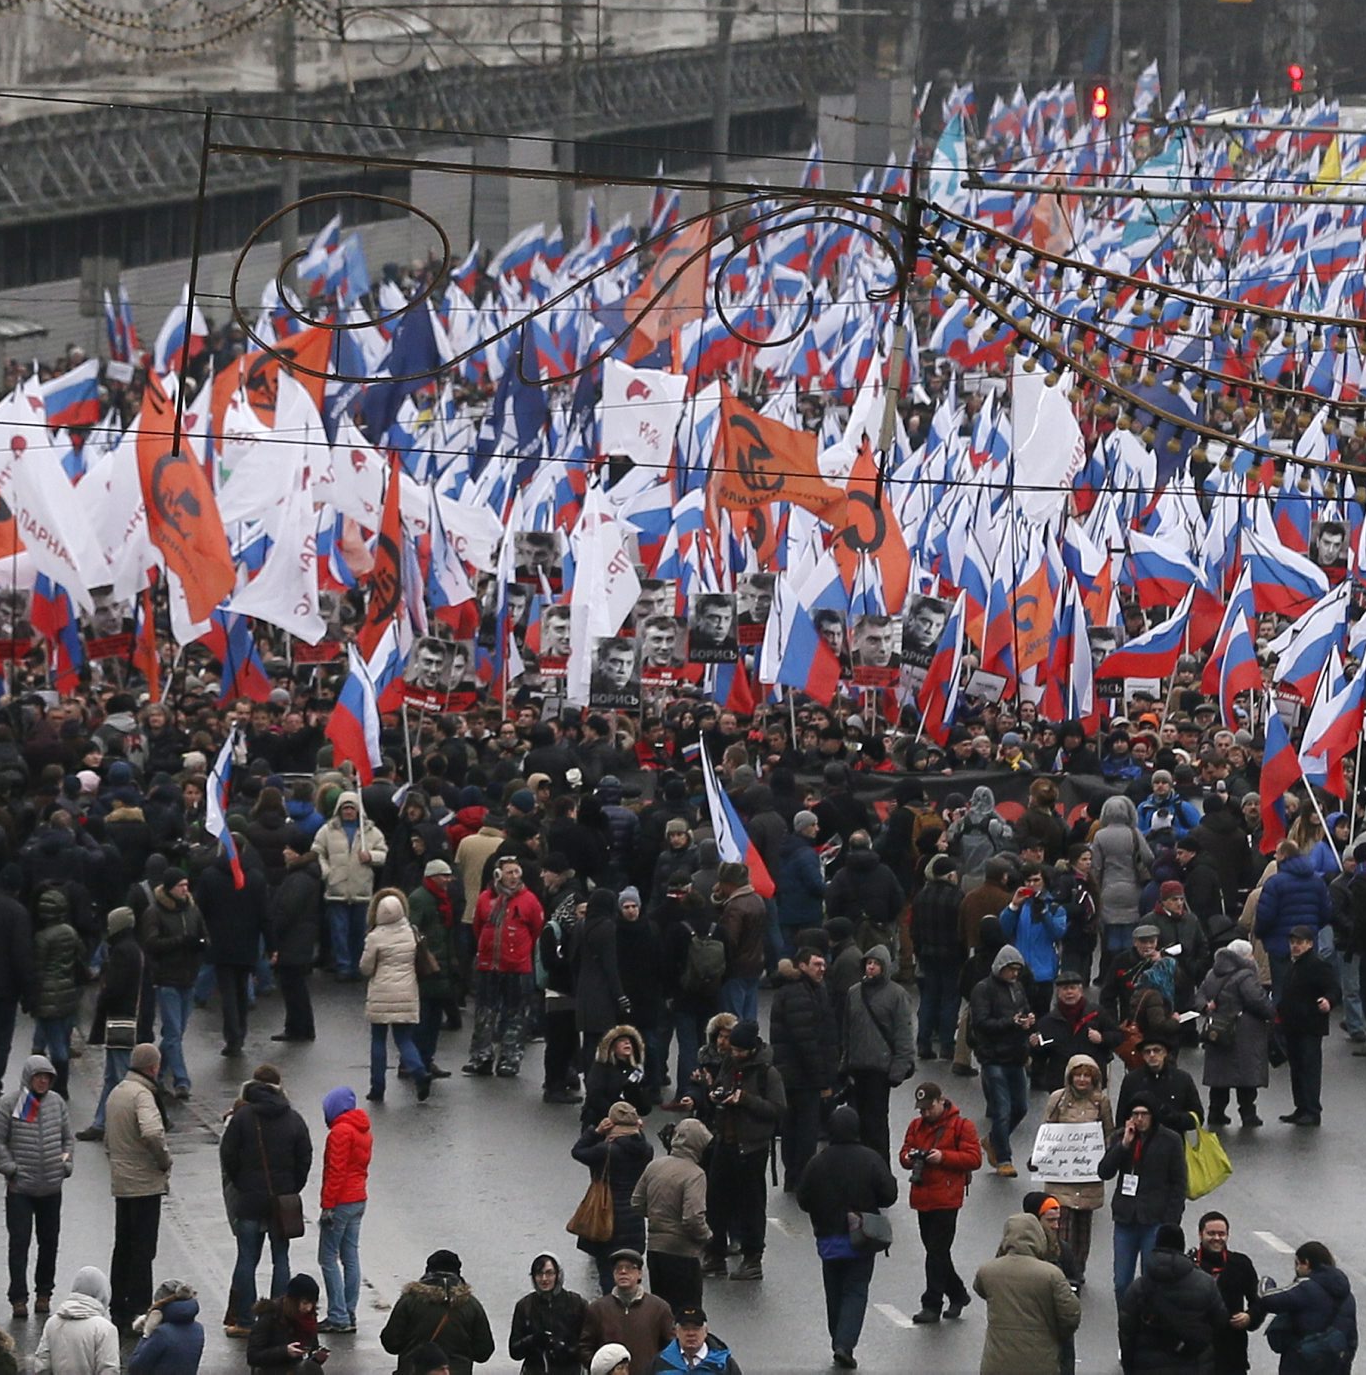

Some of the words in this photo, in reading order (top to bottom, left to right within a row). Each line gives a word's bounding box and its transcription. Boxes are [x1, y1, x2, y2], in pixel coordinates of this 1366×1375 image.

[689, 648, 737, 661] БОРИСЬ
[901, 648, 933, 666] ОРИС
[591, 691, 640, 705] БОРИСЬ
[1278, 690, 1306, 704] УМИРА
